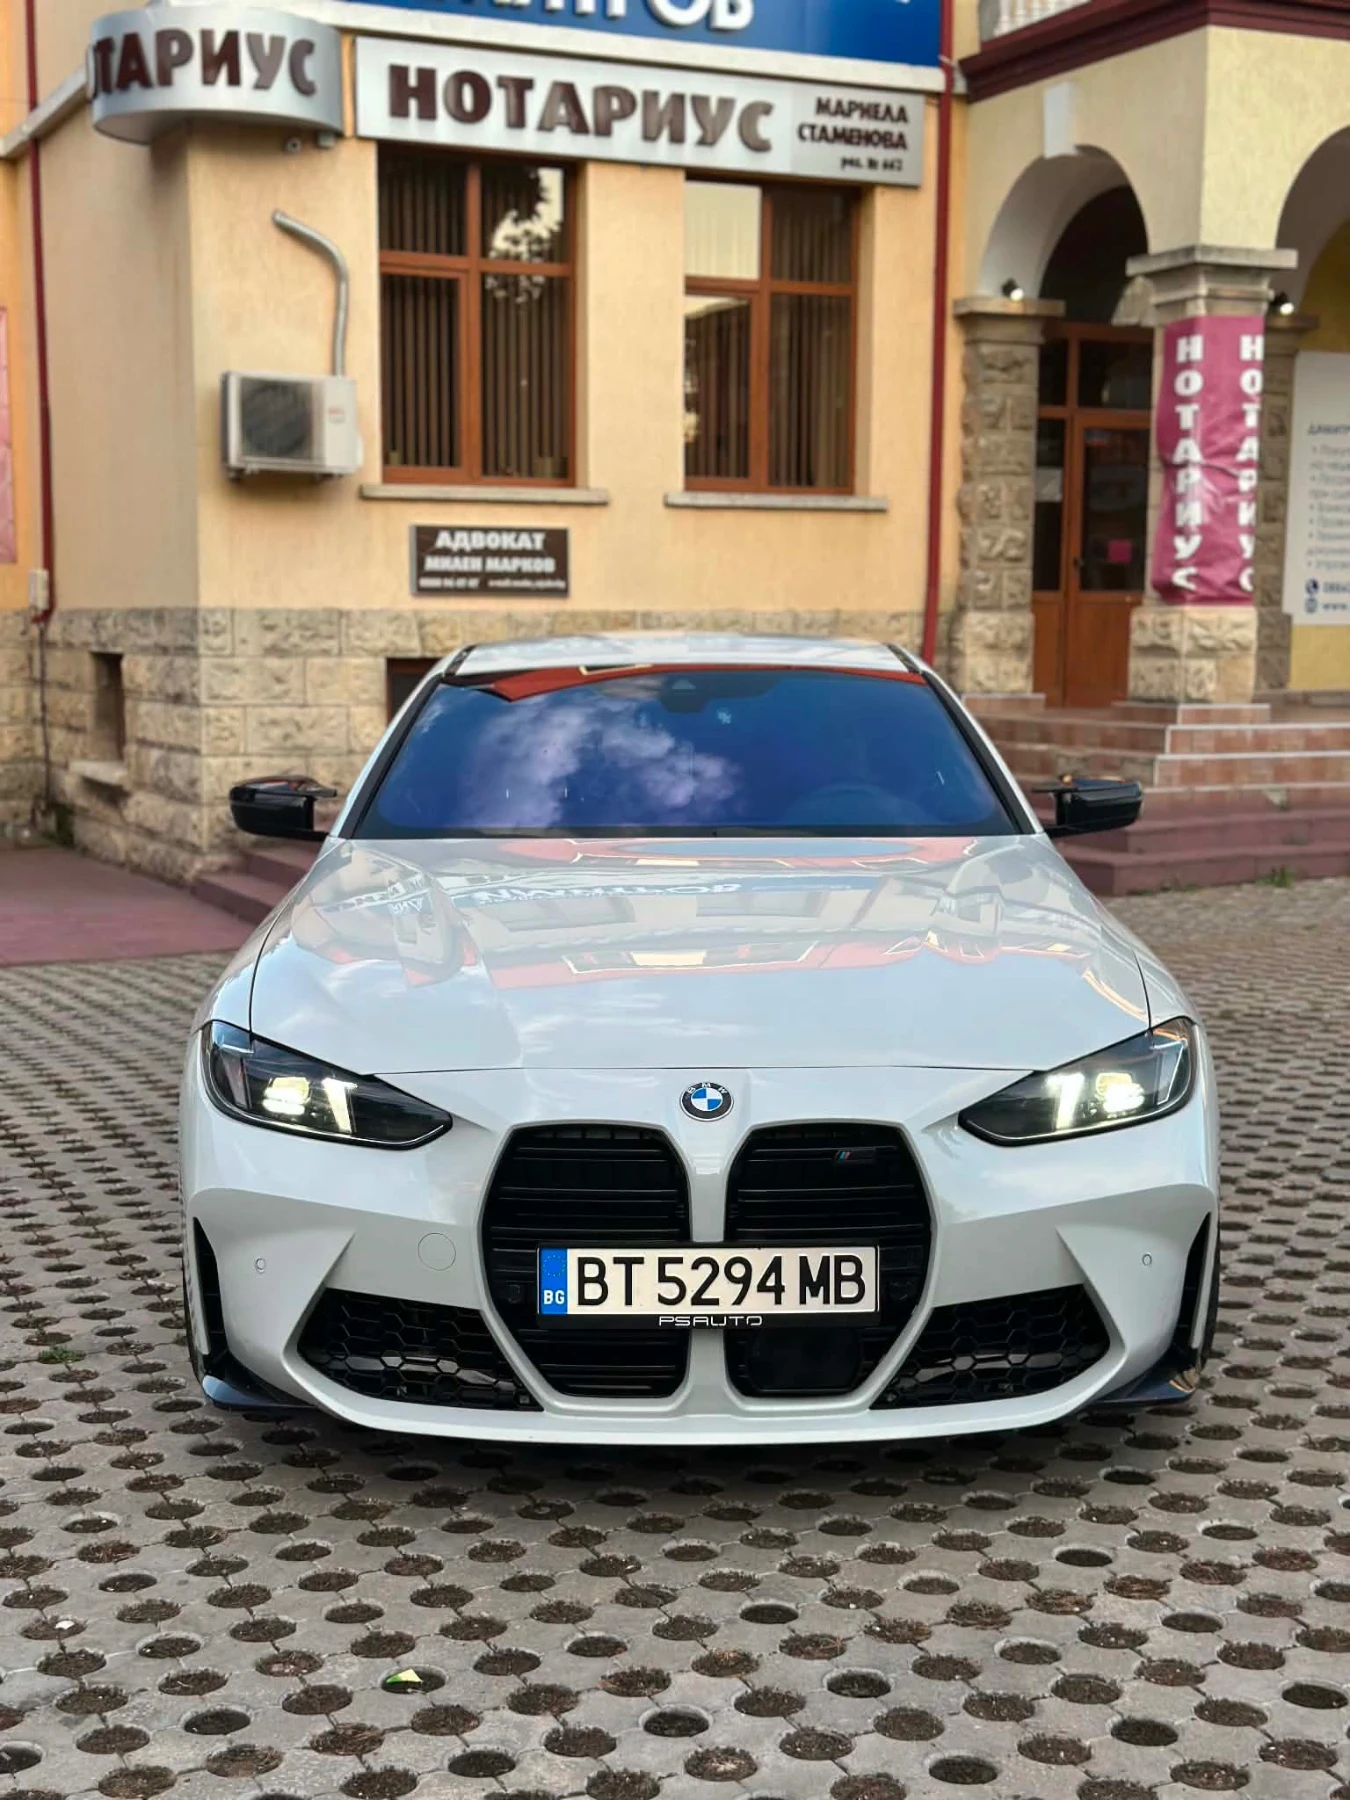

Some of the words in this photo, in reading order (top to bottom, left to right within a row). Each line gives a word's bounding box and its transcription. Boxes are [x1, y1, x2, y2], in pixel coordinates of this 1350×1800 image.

[92, 29, 316, 98] ТАРИУС
[388, 63, 775, 153] НОТАРИУС
[815, 96, 909, 124] МАРИЕЛА
[797, 123, 908, 150] СТАМЕНОВА
[1171, 333, 1204, 592] НОТАРИУС
[434, 530, 546, 552] АДВОКАТ
[576, 1256, 645, 1307] BT
[656, 1255, 786, 1306] 5294
[798, 1254, 867, 1305] MB
[542, 1289, 566, 1305] BG
[658, 1315, 764, 1327] PSAUTO
